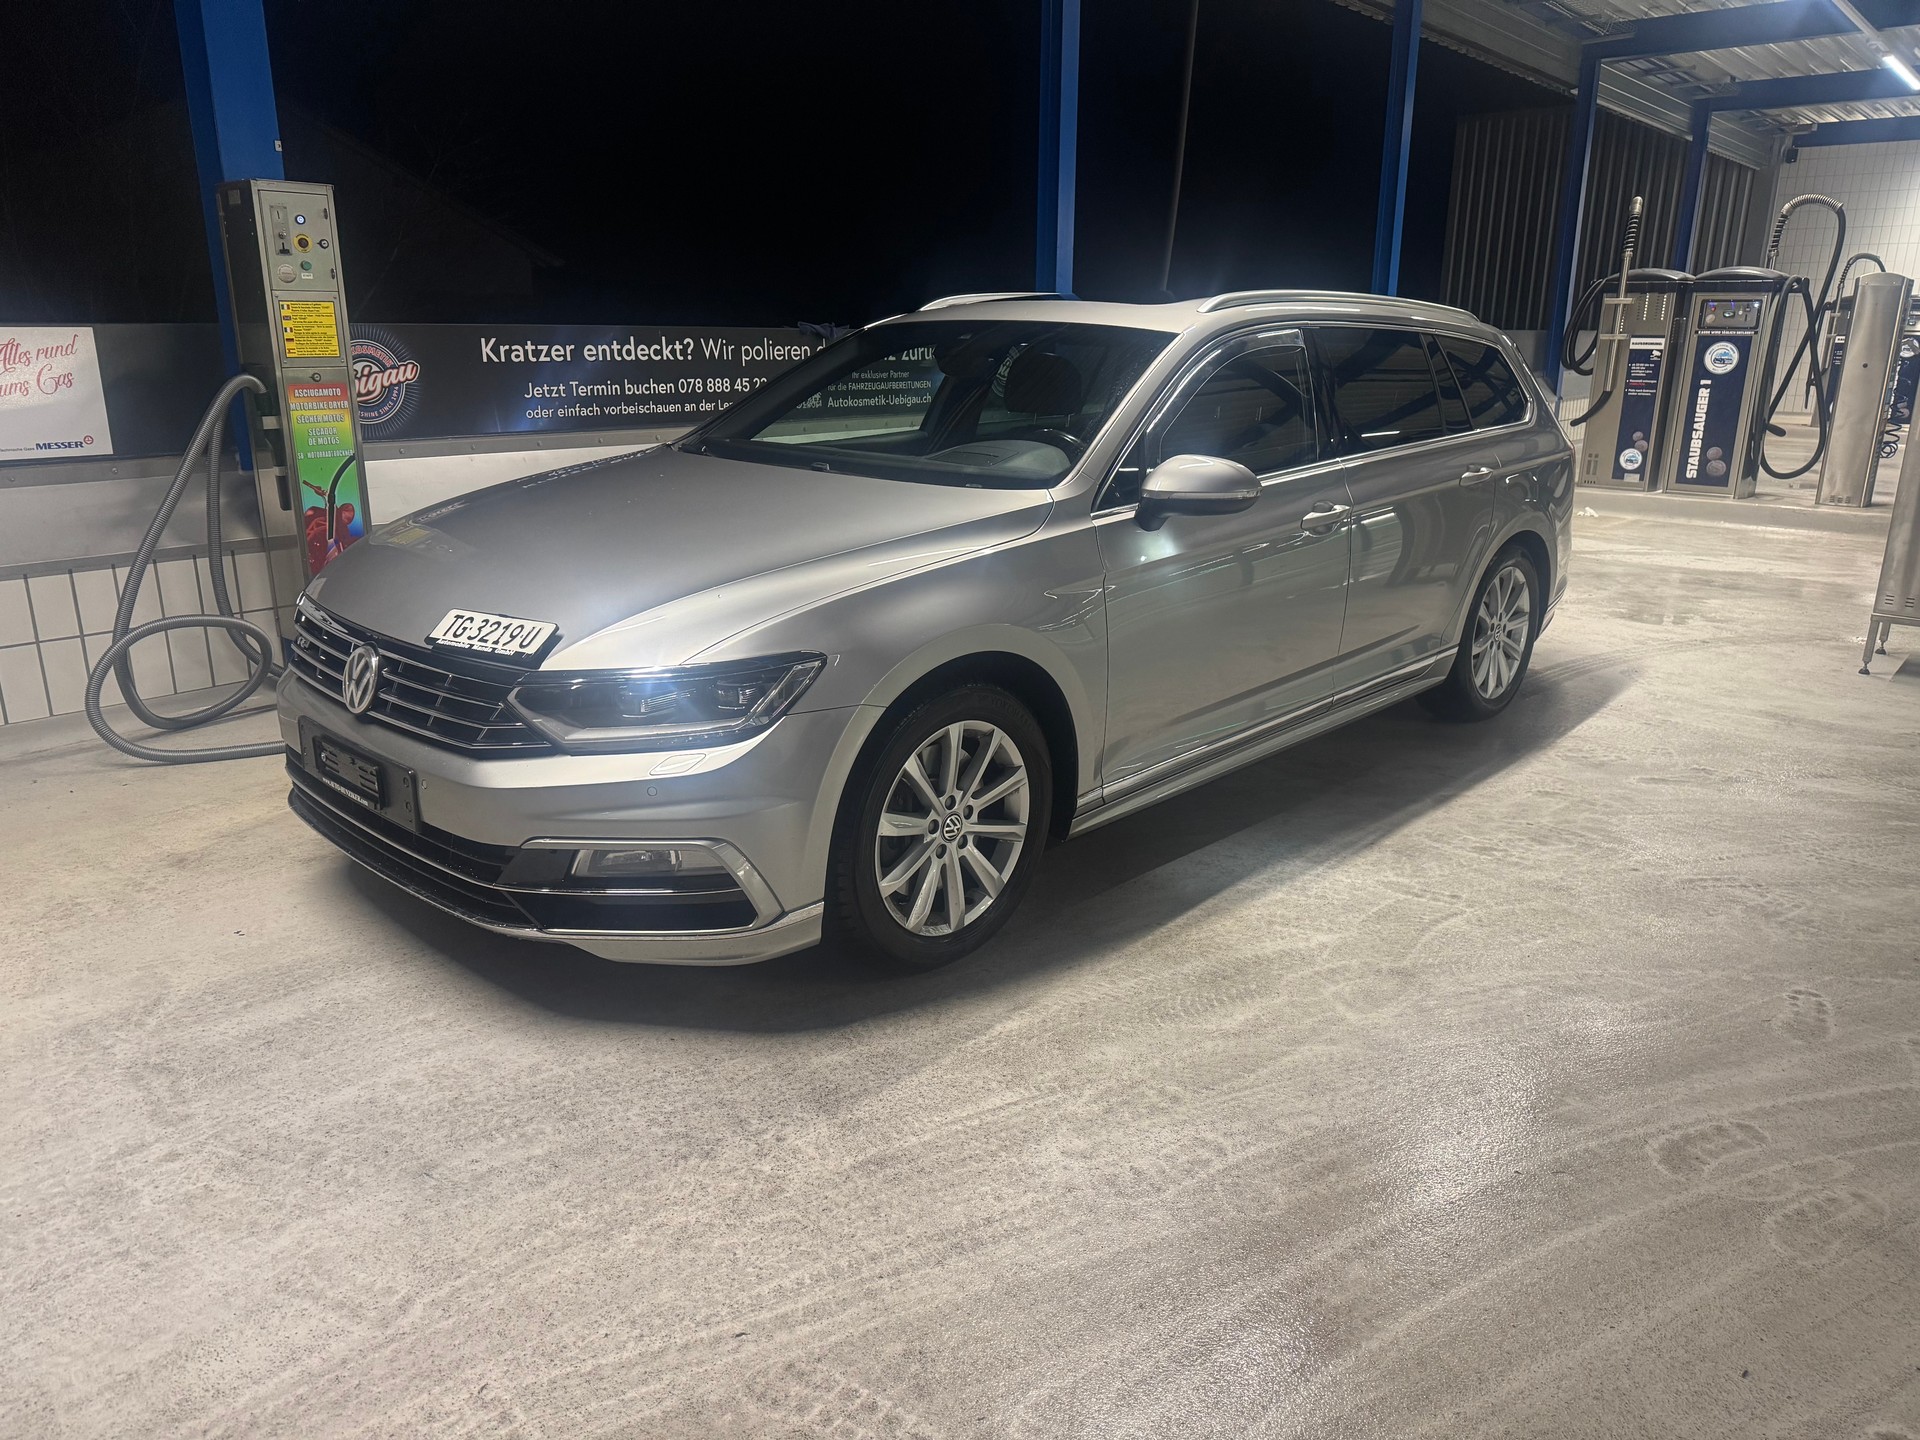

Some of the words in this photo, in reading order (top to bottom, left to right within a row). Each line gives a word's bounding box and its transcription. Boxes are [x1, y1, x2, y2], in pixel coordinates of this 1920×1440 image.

[36, 334, 78, 361] rund
[480, 337, 575, 363] Kratzer
[583, 335, 694, 361] entdeckt?
[700, 337, 735, 360] Wir
[741, 337, 811, 367] polieren
[36, 363, 75, 395] Gas
[861, 369, 889, 379] exklusiver
[890, 369, 910, 379] Partner
[524, 382, 567, 398] Jetzt
[569, 380, 621, 397] Termin
[624, 378, 675, 395] buchen
[678, 378, 703, 393] 078
[706, 377, 731, 392] 888
[734, 377, 750, 392] 45
[848, 380, 932, 390] FAHRZEUGAUFBEREITUNGEN
[294, 387, 341, 398] ASCIUGAMOTO
[290, 402, 328, 410] MOTORBIKE
[329, 400, 349, 409] DRYER
[827, 392, 932, 408] Autokosmetik-Uebigau.ch
[380, 401, 394, 414] SINCE
[525, 405, 554, 419] oder
[557, 402, 601, 417] einfach
[603, 400, 682, 415] vorbeischauen
[684, 402, 697, 412] an
[699, 399, 716, 411] der
[322, 413, 345, 423] MOTOS
[308, 427, 337, 436] SECADOR
[1686, 387, 1711, 479] STAUBSAUGER
[36, 441, 84, 451] MESSER
[308, 438, 317, 446] DE
[318, 436, 340, 445] MOTOS
